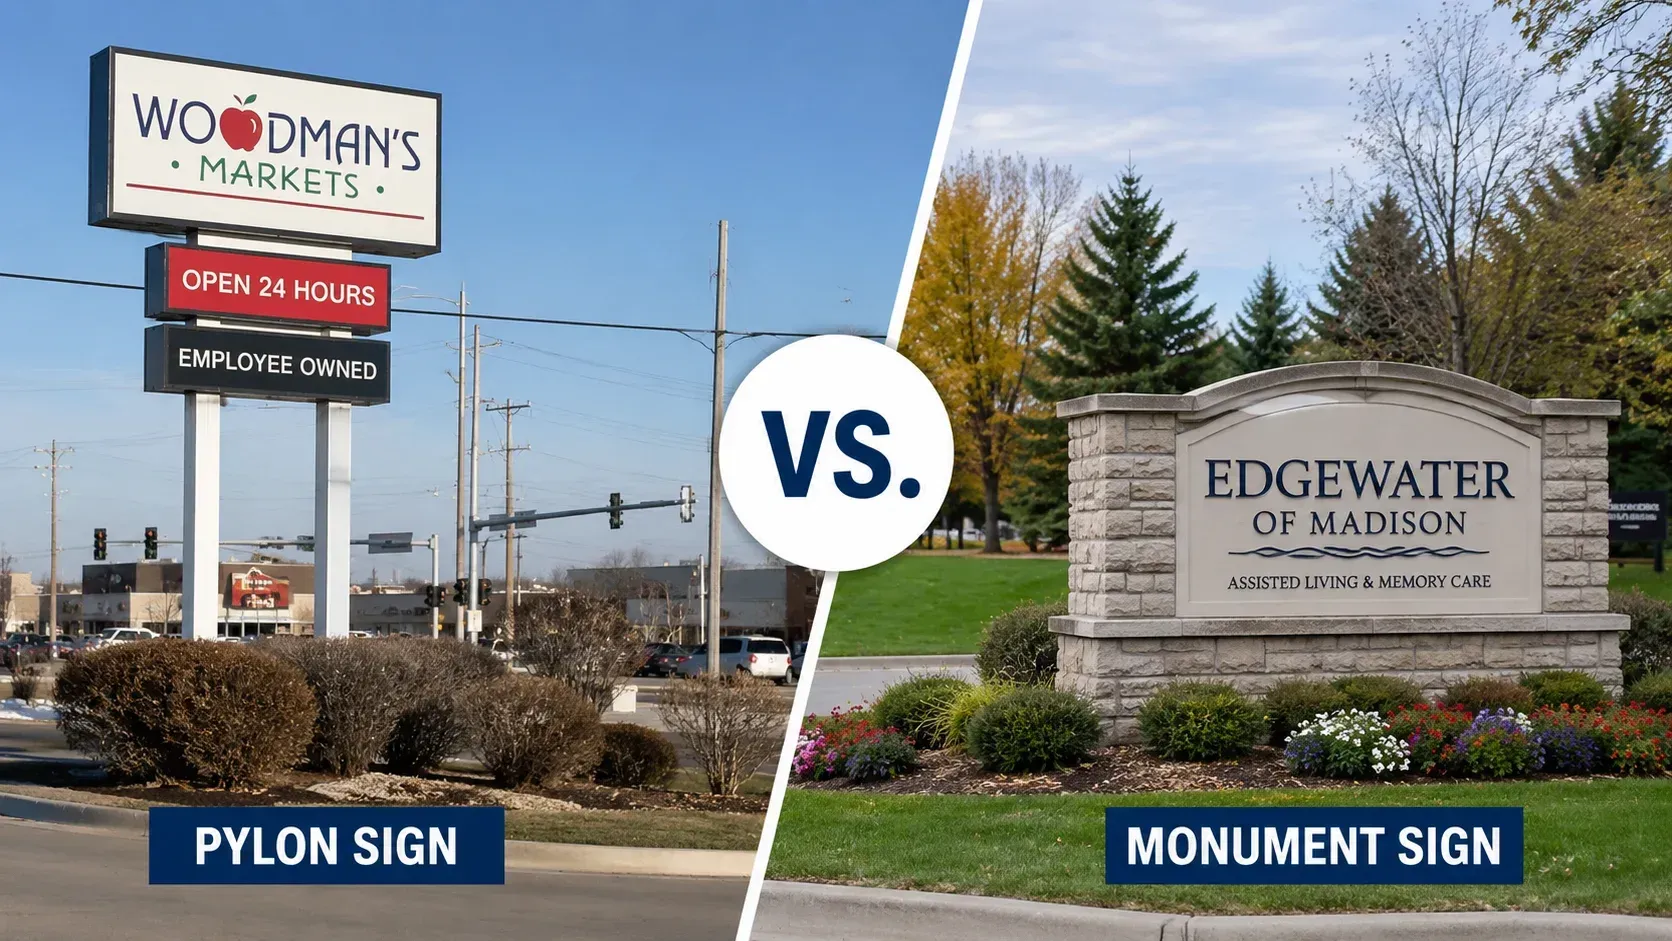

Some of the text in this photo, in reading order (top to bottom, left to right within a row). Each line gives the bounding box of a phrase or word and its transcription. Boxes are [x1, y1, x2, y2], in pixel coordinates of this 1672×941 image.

[200, 155, 359, 198] MARKETS
[182, 268, 375, 307] OPEN 24 HOURS
[178, 347, 377, 380] EMPLOYEE OWNED
[1204, 458, 1515, 500] EDGEWATER
[1252, 510, 1468, 536] OF MADISON
[1227, 574, 1492, 591] ASSISTED LIVING & MEMORY CARE
